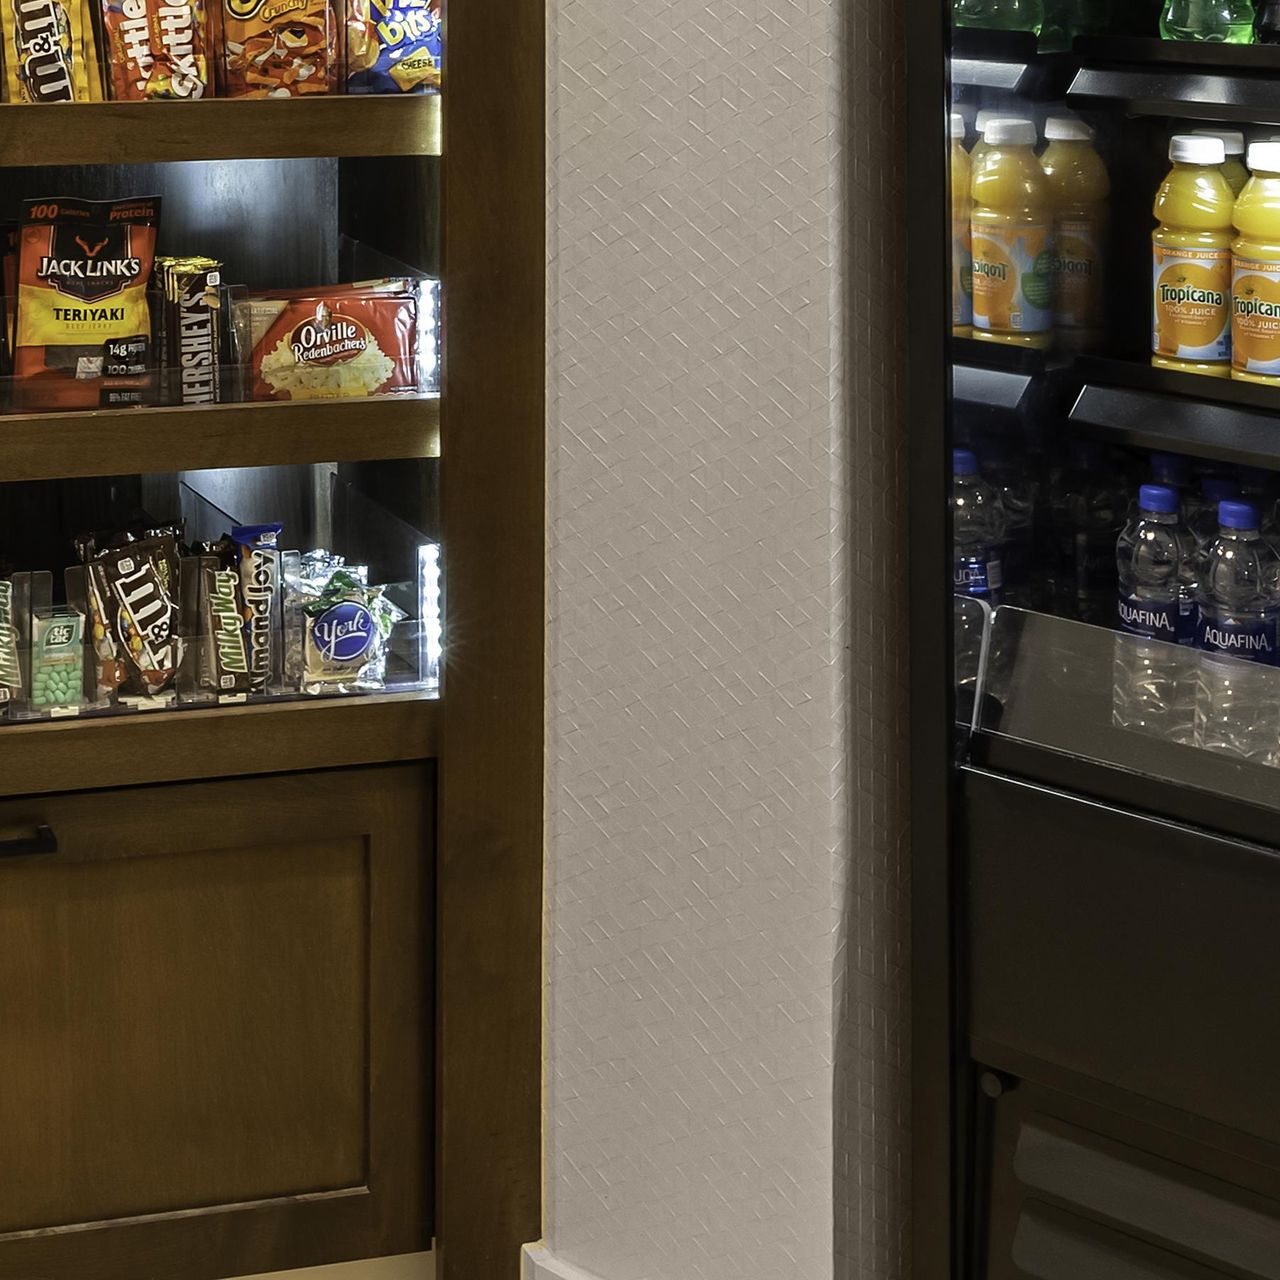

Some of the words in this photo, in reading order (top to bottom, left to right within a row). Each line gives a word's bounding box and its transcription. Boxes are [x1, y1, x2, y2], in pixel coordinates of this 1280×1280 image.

[401, 58, 433, 70] CHEESE
[1162, 249, 1193, 259] ORANGE
[1195, 251, 1219, 259] JUICE
[38, 257, 86, 278] JACK
[86, 257, 140, 277] LINK'S
[1160, 283, 1222, 306] Tropicana
[53, 308, 125, 321] TERIYAKI
[301, 322, 357, 348] Orville
[293, 337, 367, 363] Redenbacher's
[49, 634, 69, 644] tac
[52, 625, 70, 636] tic
[314, 610, 370, 663] York
[1204, 626, 1268, 652] AQUAFINA
